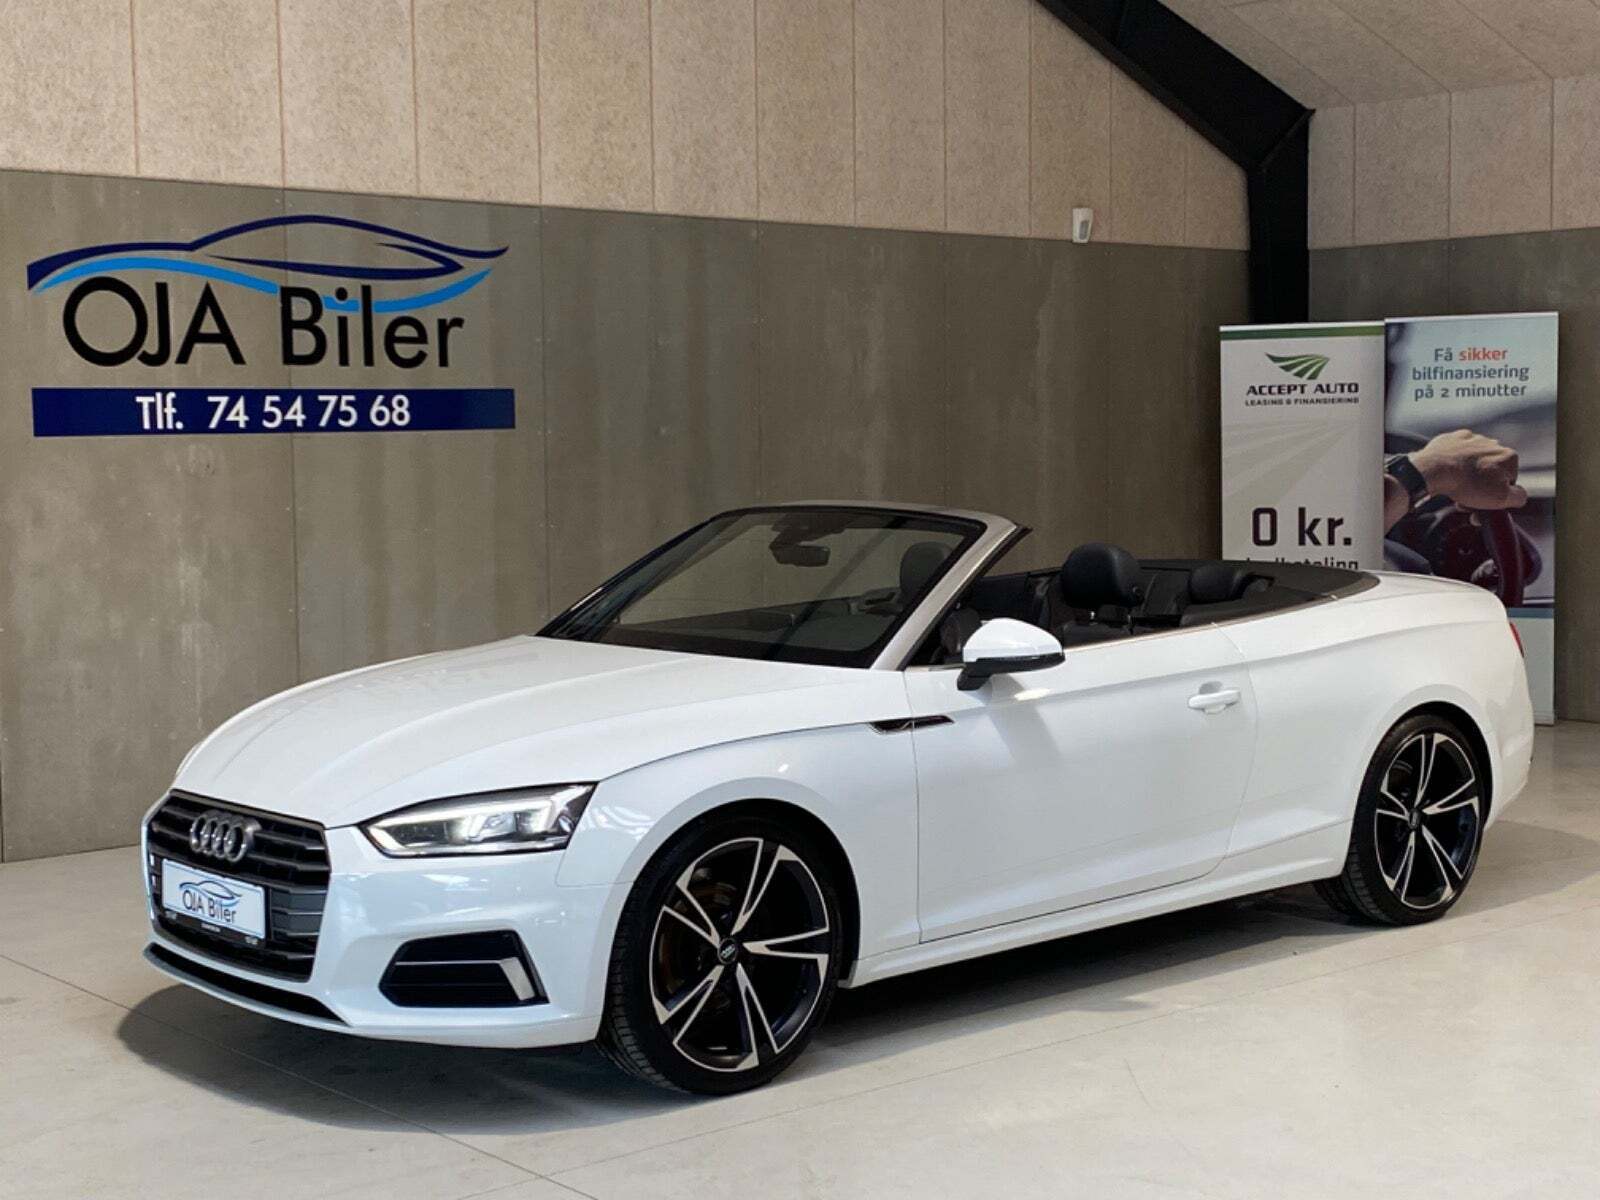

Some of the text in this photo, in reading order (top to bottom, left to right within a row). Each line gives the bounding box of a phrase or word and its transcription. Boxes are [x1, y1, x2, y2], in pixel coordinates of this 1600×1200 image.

[62, 276, 464, 369] OJA Biler
[1434, 347, 1508, 362] Få sikker
[1412, 364, 1530, 382] bilfinansiering
[1246, 382, 1360, 396] ACCEPT AUTO
[1414, 383, 1527, 402] på 2 minutter
[135, 392, 411, 430] Tlf. 74 54 75 68
[1298, 506, 1352, 546] kr.
[208, 897, 237, 924] Biler
